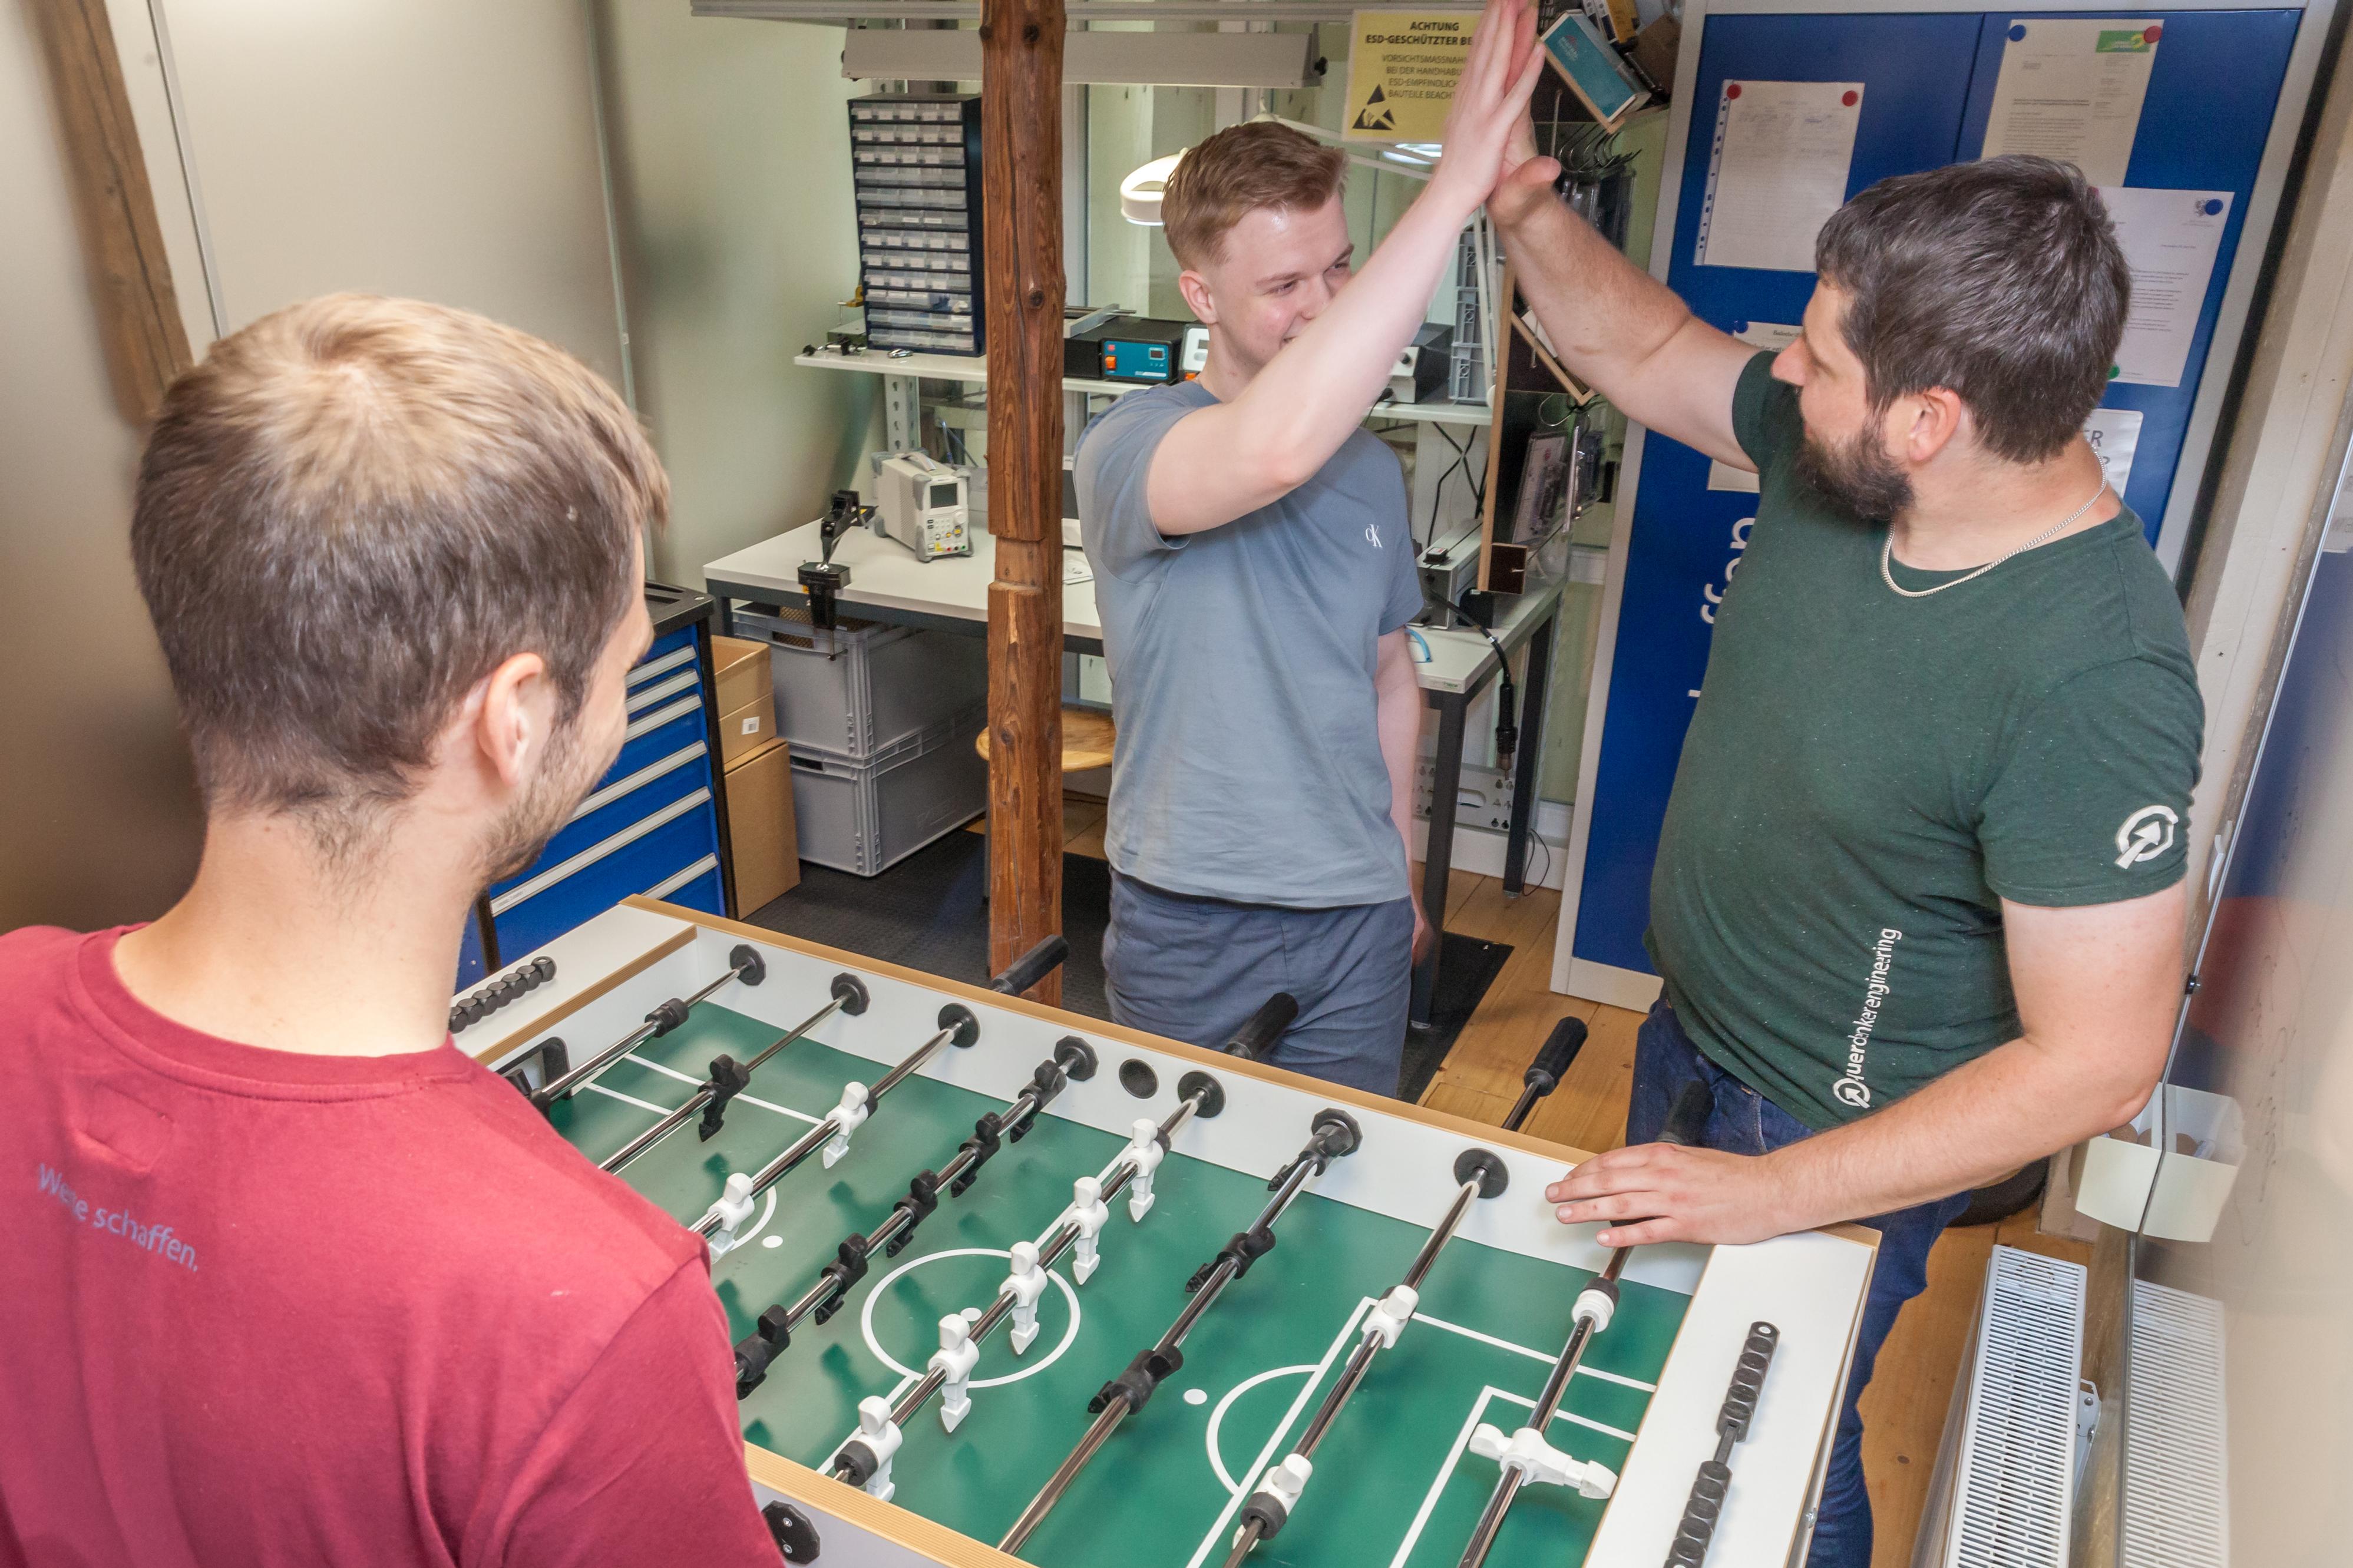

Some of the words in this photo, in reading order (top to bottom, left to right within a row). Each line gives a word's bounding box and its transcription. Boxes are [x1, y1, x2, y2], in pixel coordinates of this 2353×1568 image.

[1410, 21, 1460, 31] ACHTUNG
[1366, 34, 1458, 45] ESD-GESCHÜTZTER
[1383, 54, 1468, 64] VORSICHTSMASSNAH
[92, 1208, 199, 1272] schaffen.
